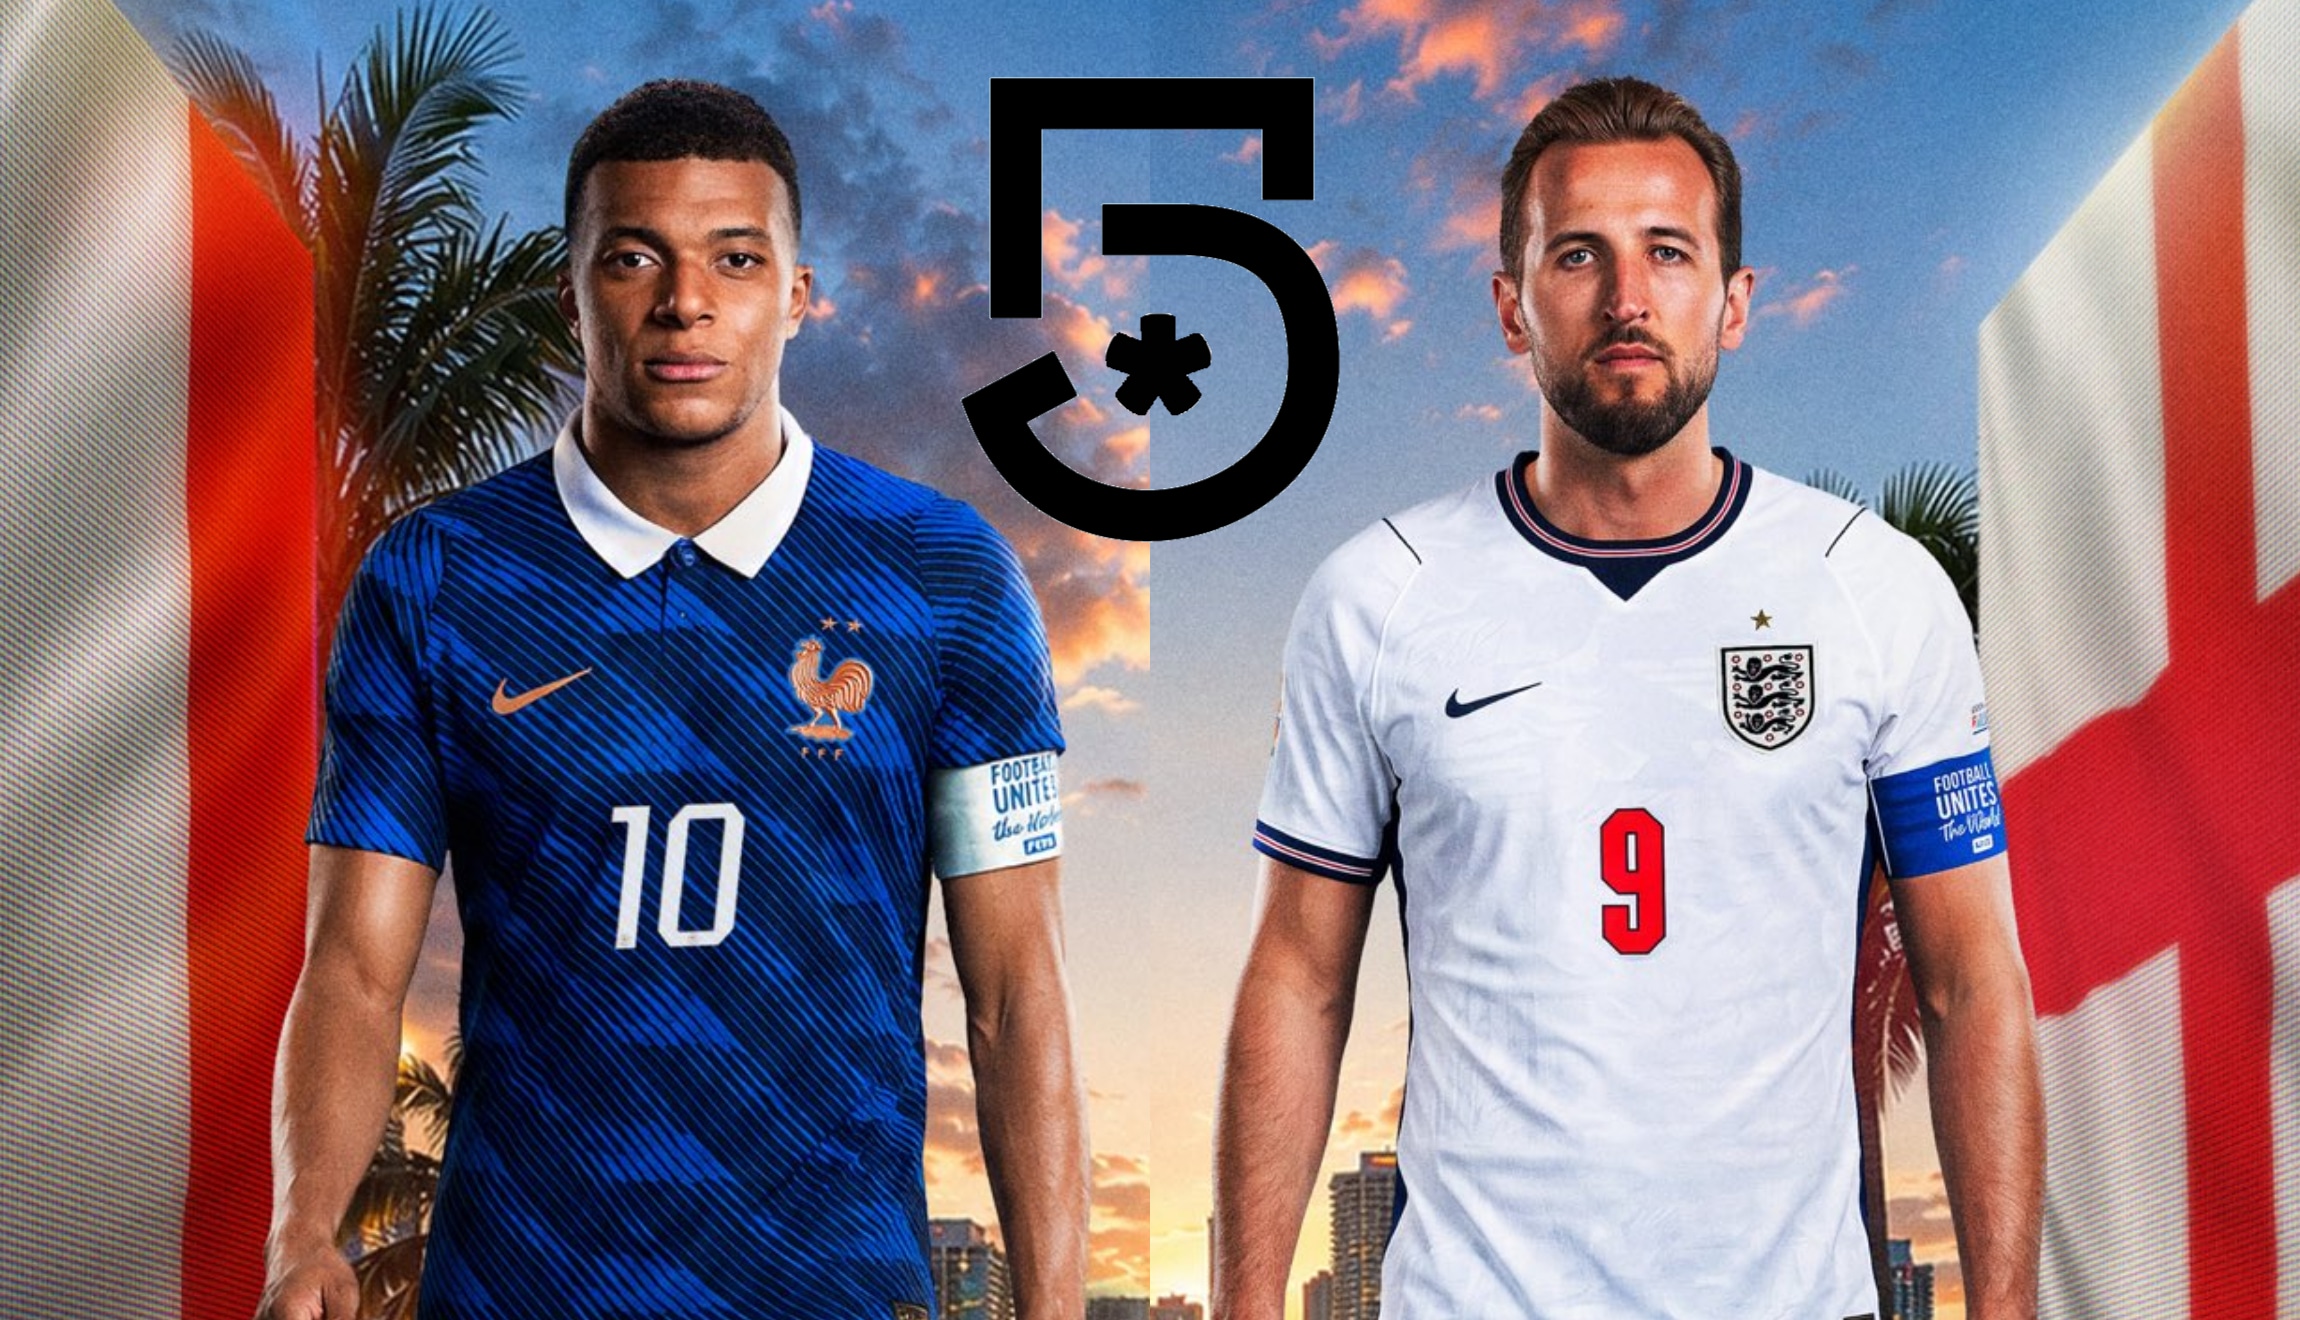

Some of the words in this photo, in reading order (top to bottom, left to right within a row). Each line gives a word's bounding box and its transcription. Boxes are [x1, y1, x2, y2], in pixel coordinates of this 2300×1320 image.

[1934, 762, 1991, 793] FOOTBALL
[1936, 781, 1997, 820] UNITES
[611, 803, 745, 949] 10
[1600, 807, 1666, 955] 9
